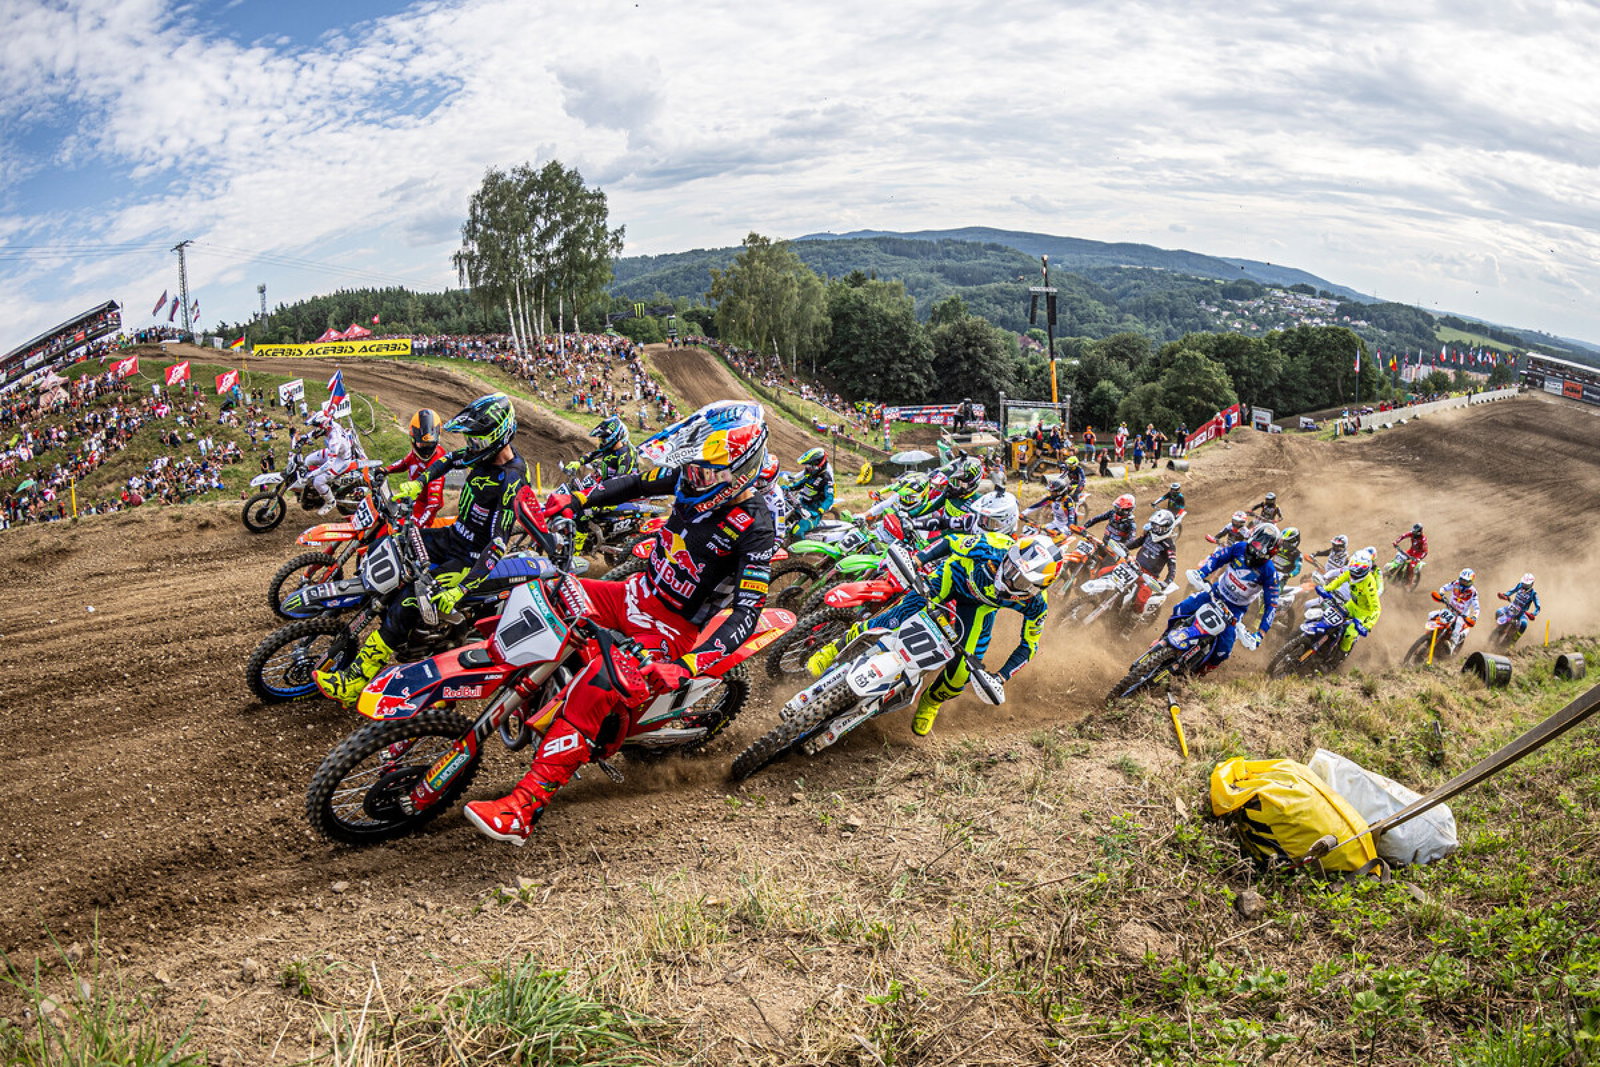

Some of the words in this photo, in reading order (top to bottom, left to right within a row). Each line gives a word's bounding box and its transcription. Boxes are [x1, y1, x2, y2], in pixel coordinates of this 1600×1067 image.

[254, 348, 303, 357] ACERBIS
[305, 345, 355, 356] ACERBIS
[358, 342, 409, 353] ACERBIS
[694, 491, 724, 513] Red
[722, 473, 750, 498] Bull
[357, 499, 374, 528] 253
[368, 545, 396, 585] 10
[1114, 563, 1134, 585] 224
[661, 566, 697, 600] Bull
[499, 607, 547, 650] 1
[1199, 609, 1222, 630] 6
[899, 619, 948, 669] 101
[443, 686, 463, 699] Red
[462, 684, 483, 697] Bull
[426, 750, 460, 780] PIRELL
[440, 753, 470, 784] MOTOREX
